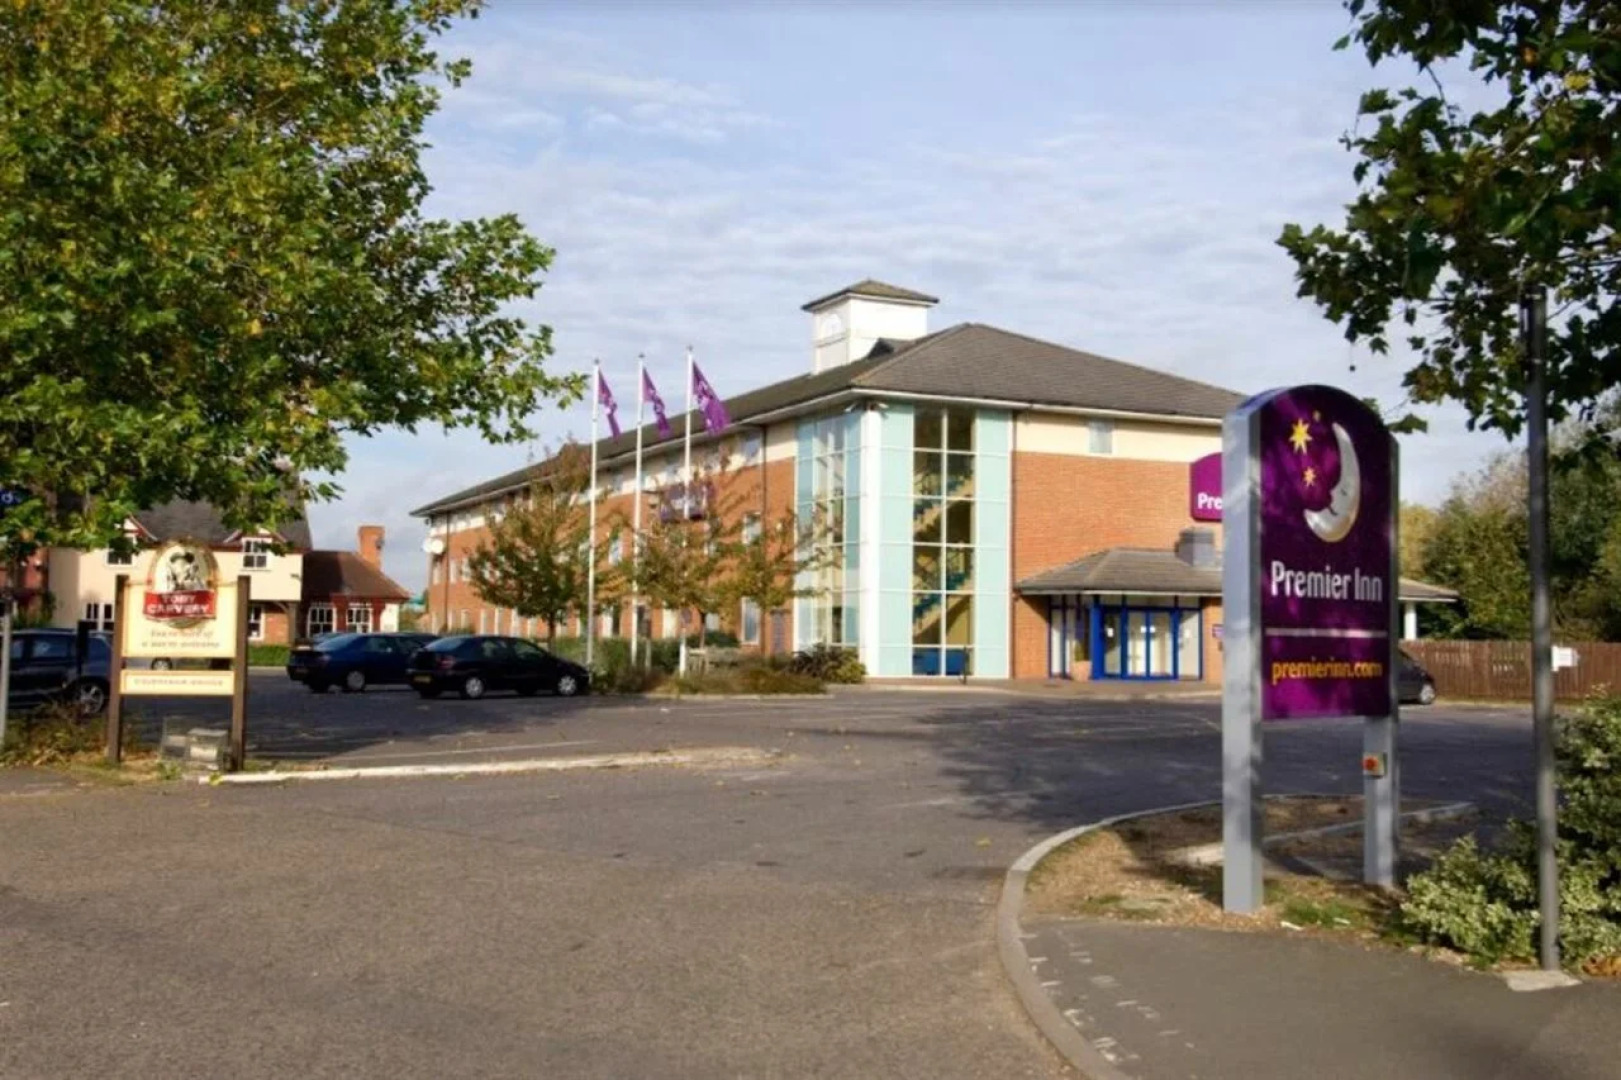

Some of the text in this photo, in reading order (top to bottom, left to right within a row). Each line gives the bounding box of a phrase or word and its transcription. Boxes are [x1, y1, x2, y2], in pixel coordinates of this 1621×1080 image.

[1271, 560, 1382, 601] Premier Inn
[1271, 657, 1383, 686] premierinn.com
